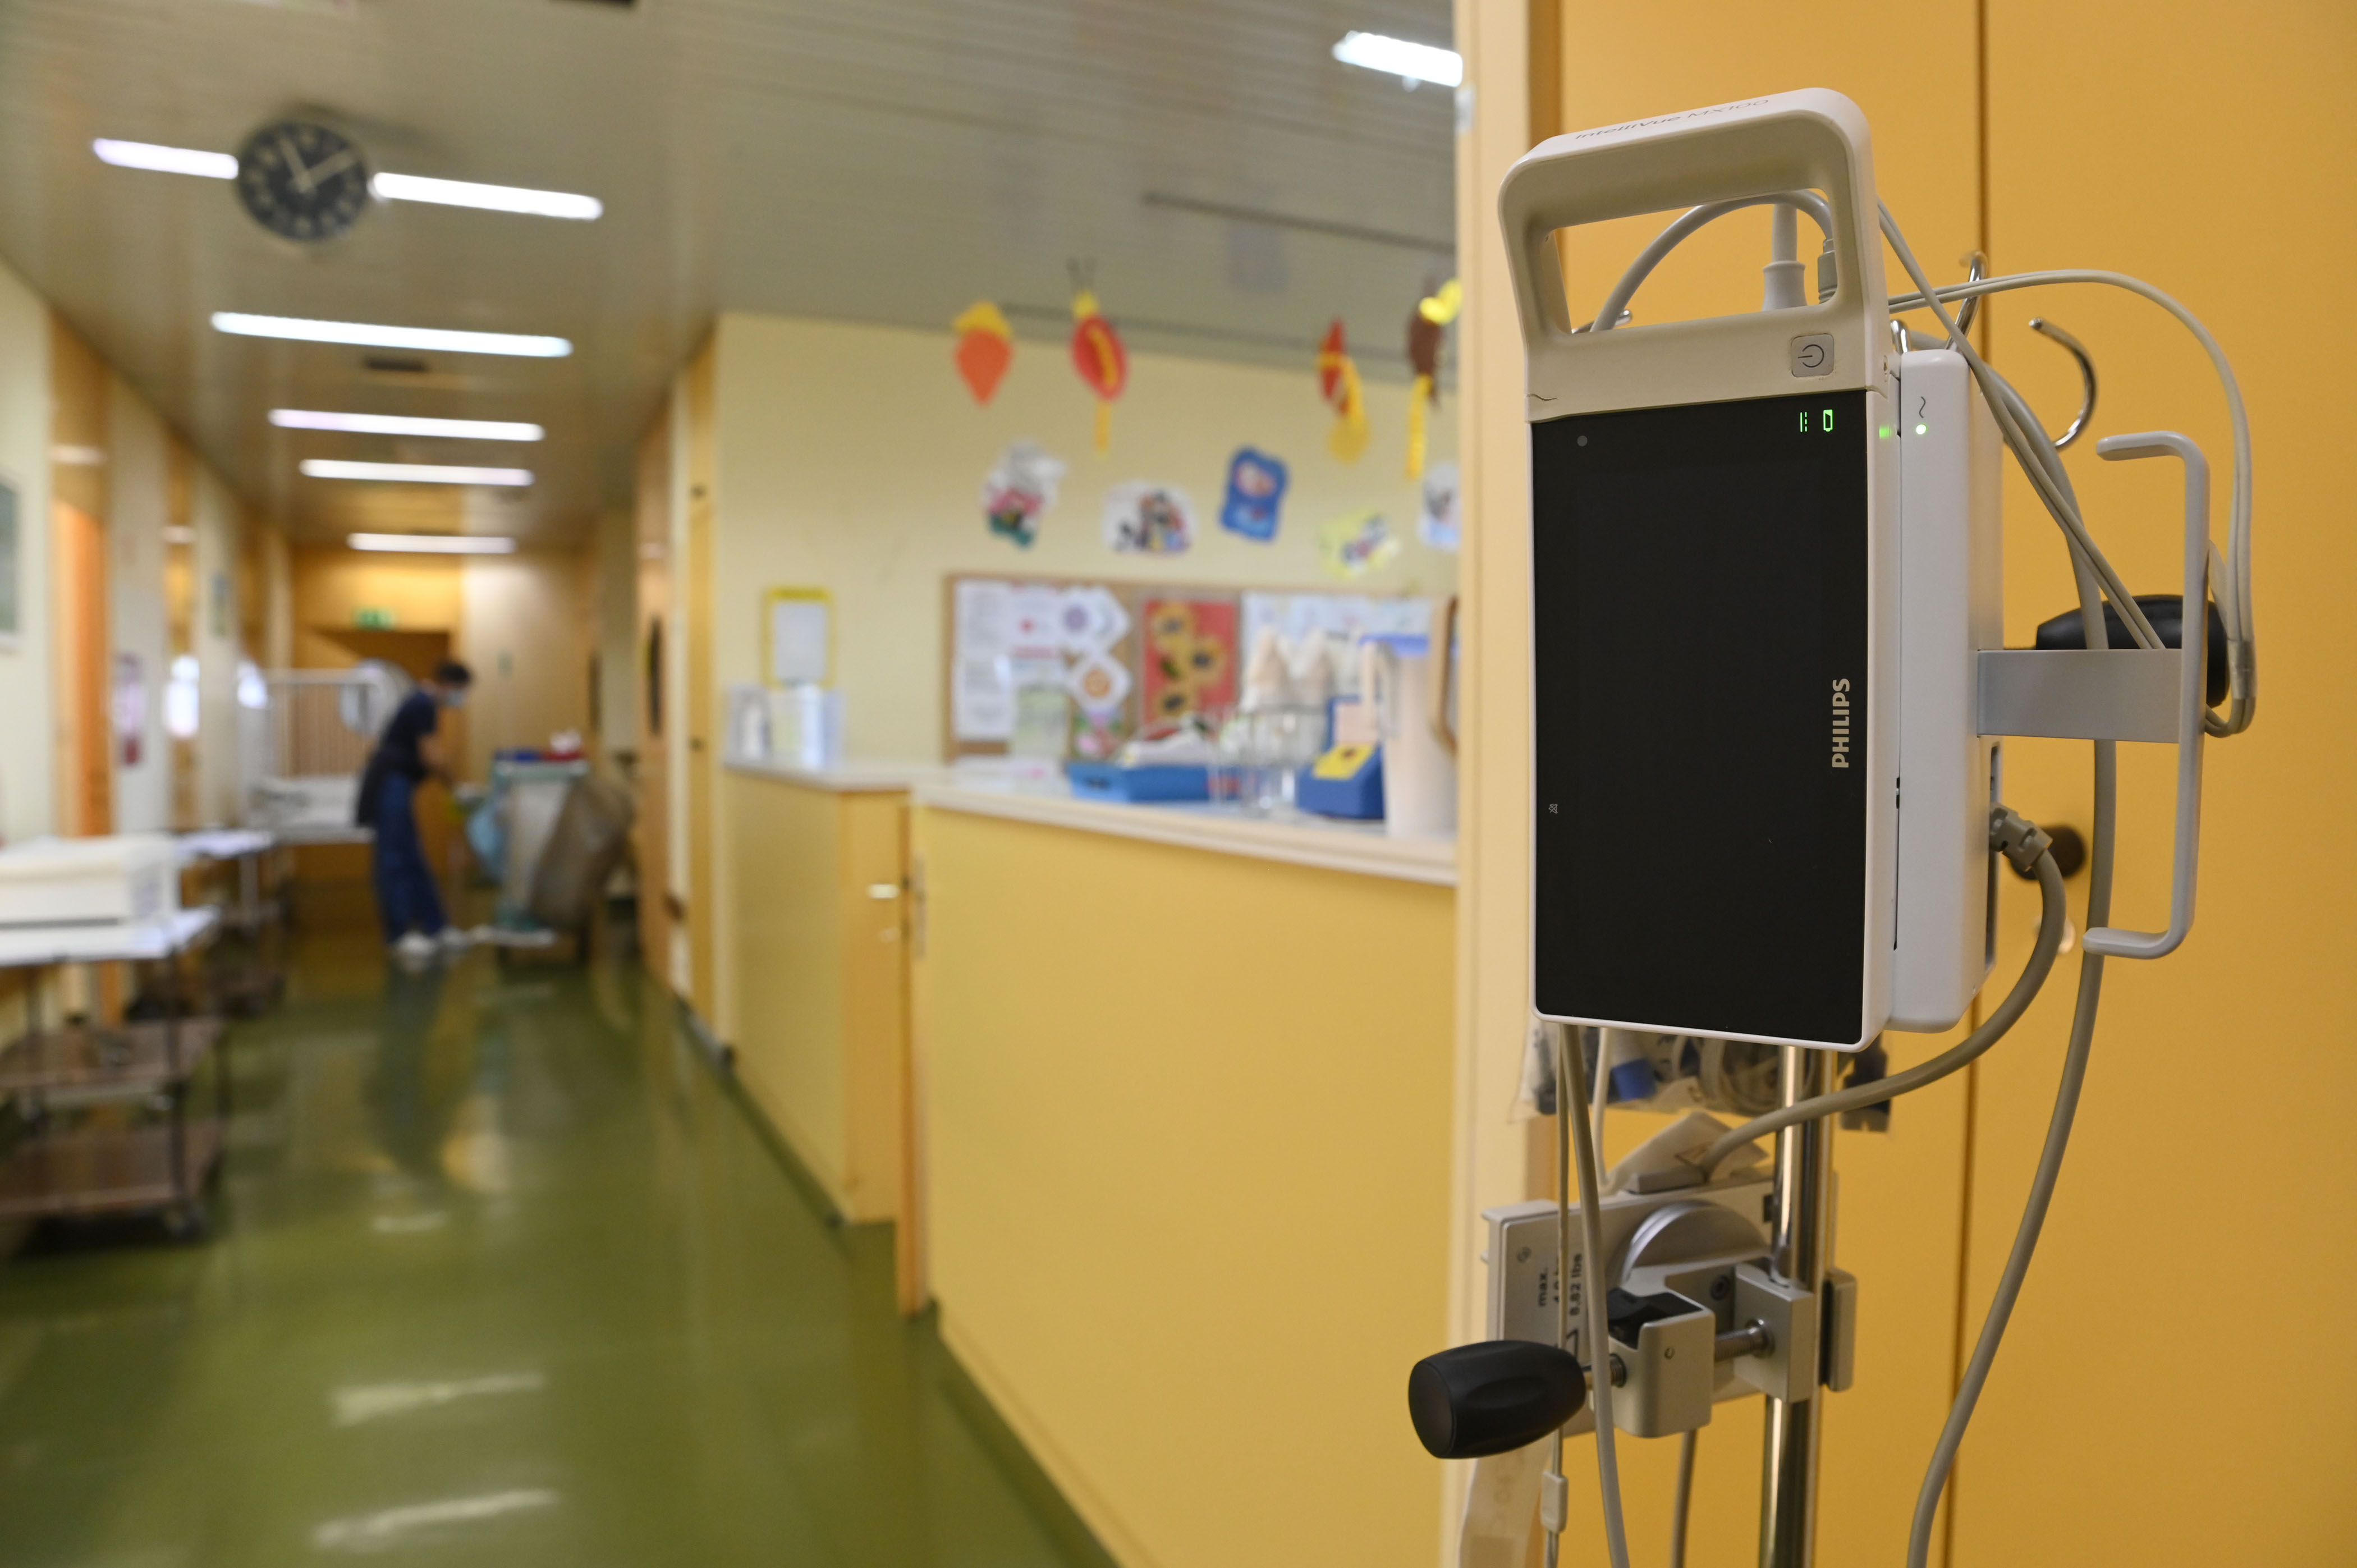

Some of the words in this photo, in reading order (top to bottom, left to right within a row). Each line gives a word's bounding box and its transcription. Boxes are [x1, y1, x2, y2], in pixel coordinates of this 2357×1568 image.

[1575, 116, 1681, 140] IntelliVue
[1687, 99, 1769, 118] MX100
[1831, 678, 1851, 768] PHILIPS
[1571, 1254, 1582, 1278] lbs
